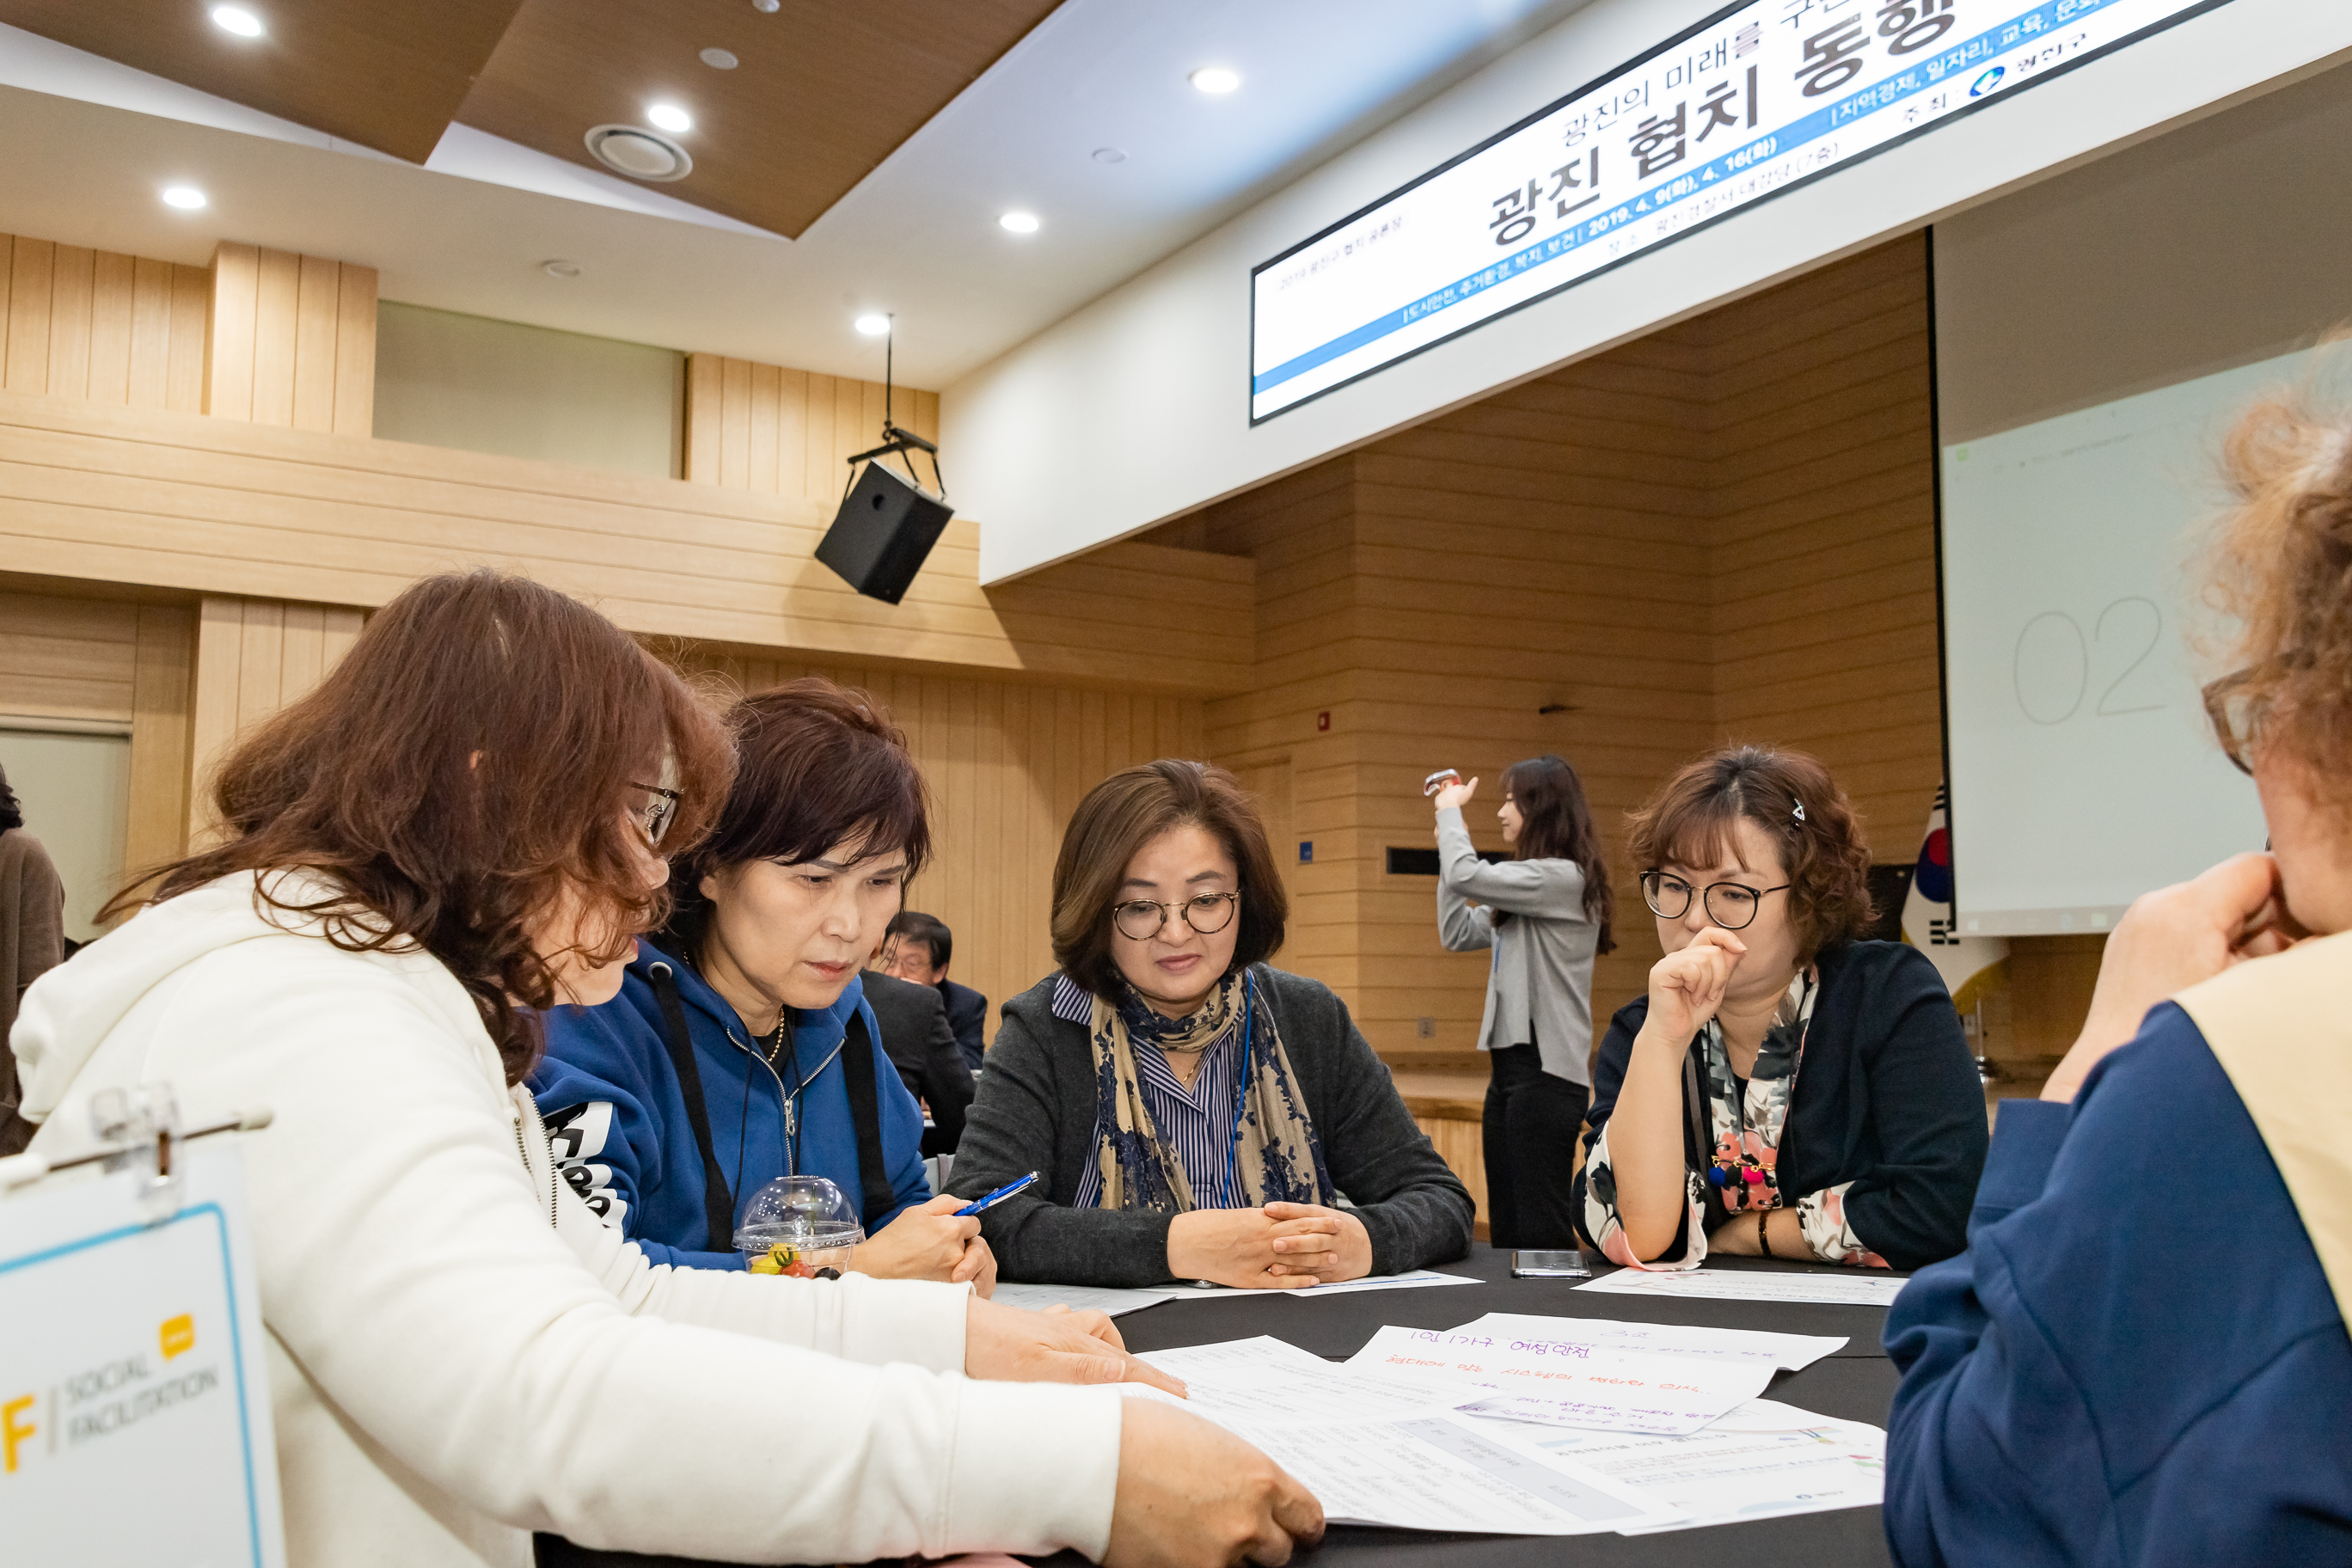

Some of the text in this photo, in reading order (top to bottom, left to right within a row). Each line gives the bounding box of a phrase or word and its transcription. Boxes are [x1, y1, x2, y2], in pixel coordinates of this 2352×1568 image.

[1489, 0, 1955, 246] 광진 협치 동행
[1563, 0, 1851, 147] 광진의 미래를 구
[2013, 595, 2169, 726] 02
[64, 1352, 150, 1408] SOCIAL
[68, 1363, 219, 1449] FACILITATION
